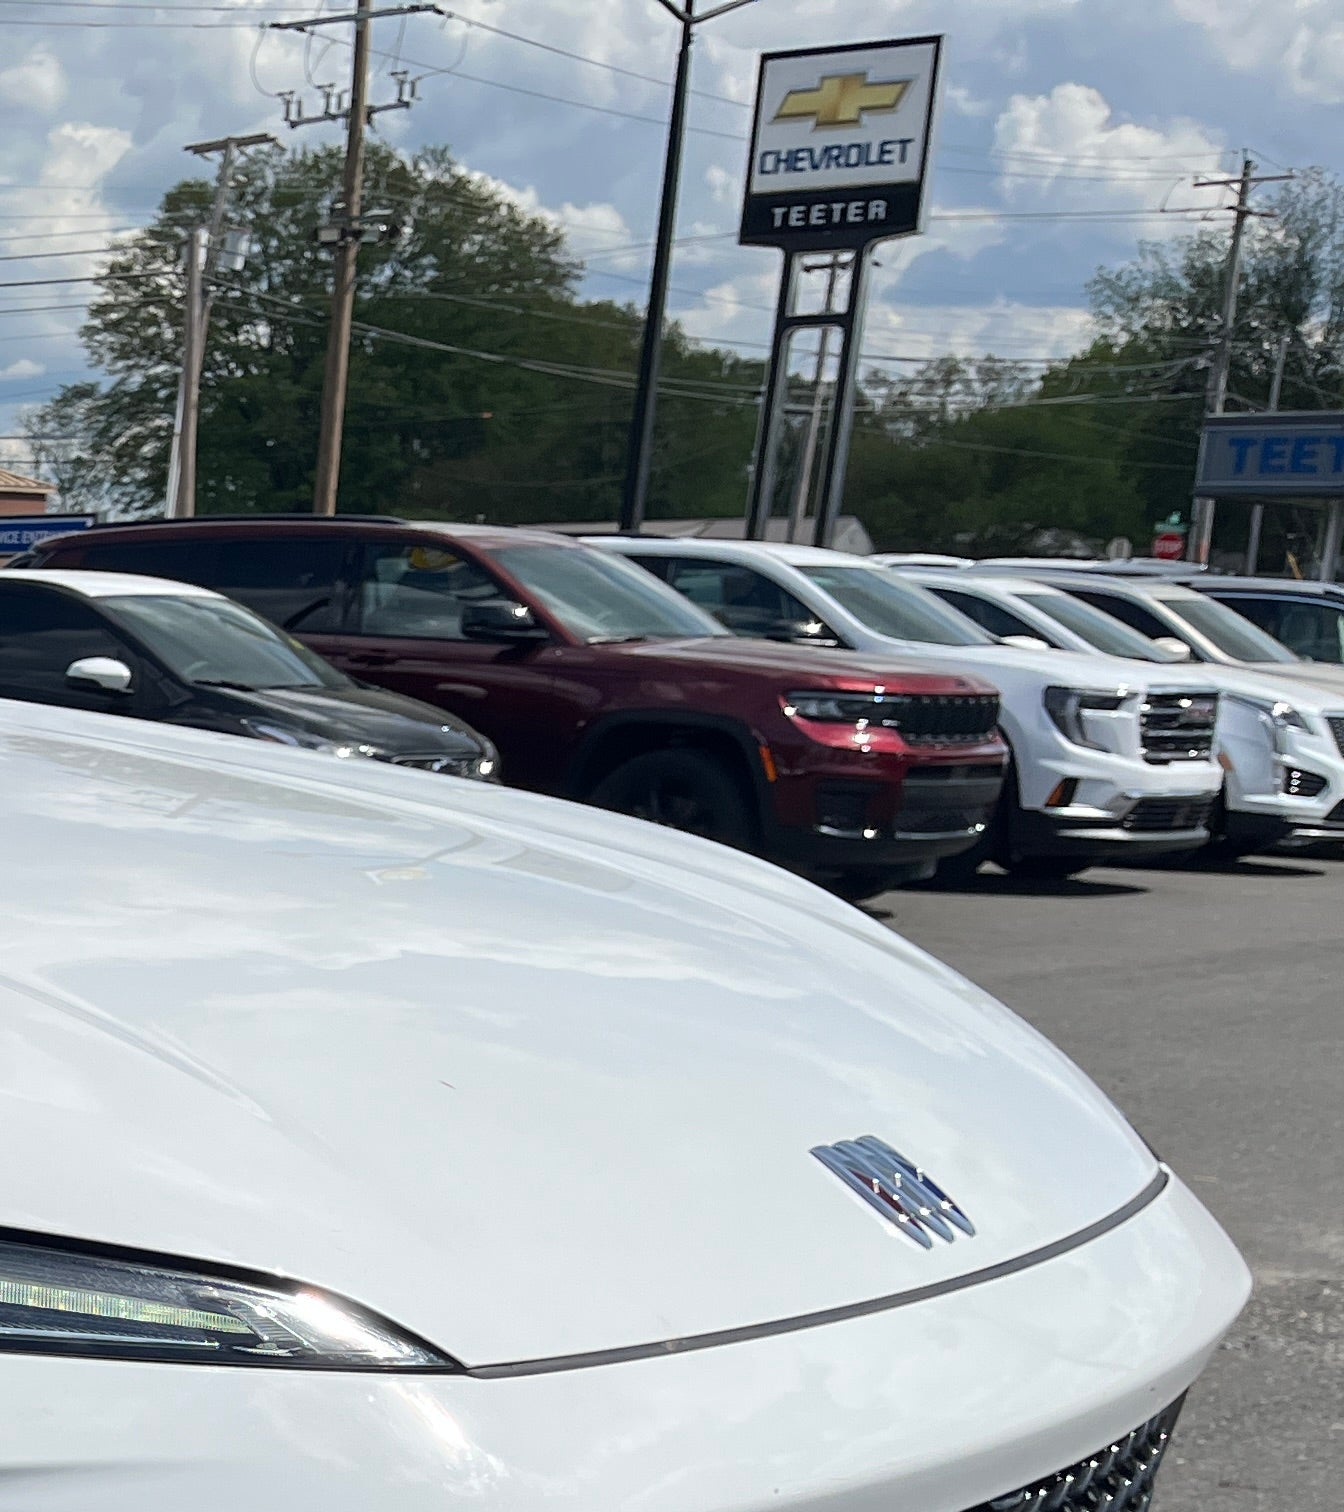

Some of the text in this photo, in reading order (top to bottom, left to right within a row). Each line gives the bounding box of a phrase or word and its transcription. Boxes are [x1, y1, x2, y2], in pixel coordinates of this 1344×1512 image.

[759, 138, 915, 174] CHEVROLET
[772, 200, 888, 227] TEETER
[1229, 436, 1344, 475] TEET
